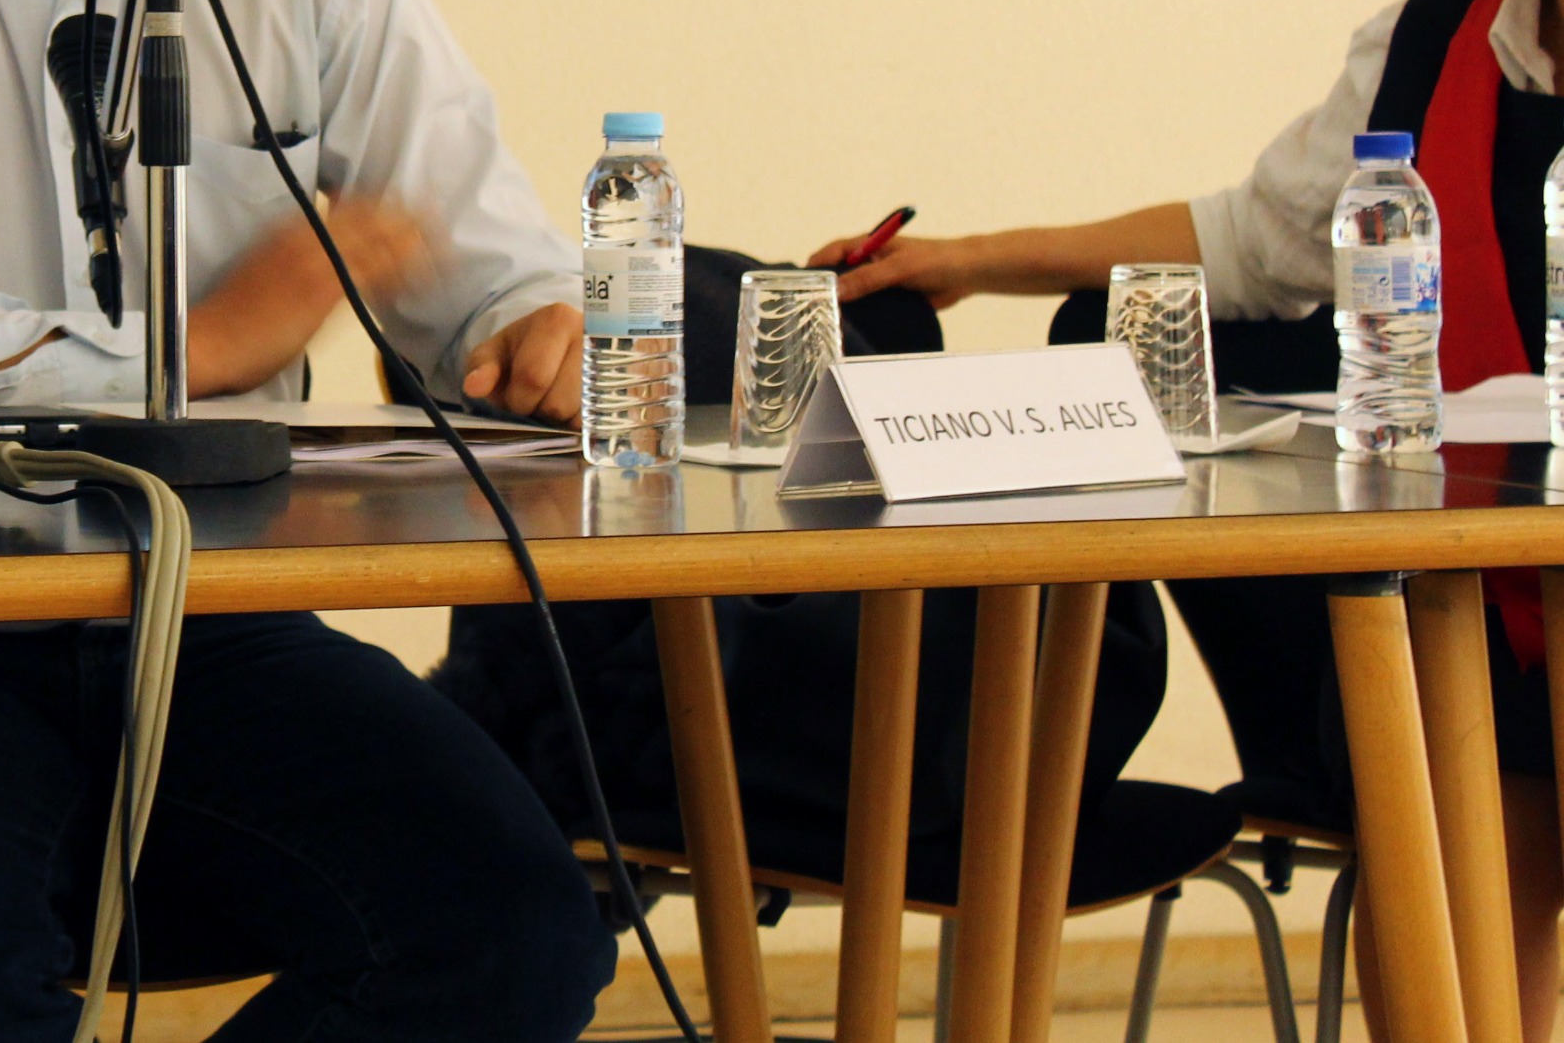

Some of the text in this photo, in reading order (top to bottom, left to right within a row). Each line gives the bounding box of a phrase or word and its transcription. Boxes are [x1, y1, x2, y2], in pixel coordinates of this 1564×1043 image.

[874, 401, 1137, 444] TICIANO V. S. ALVES
